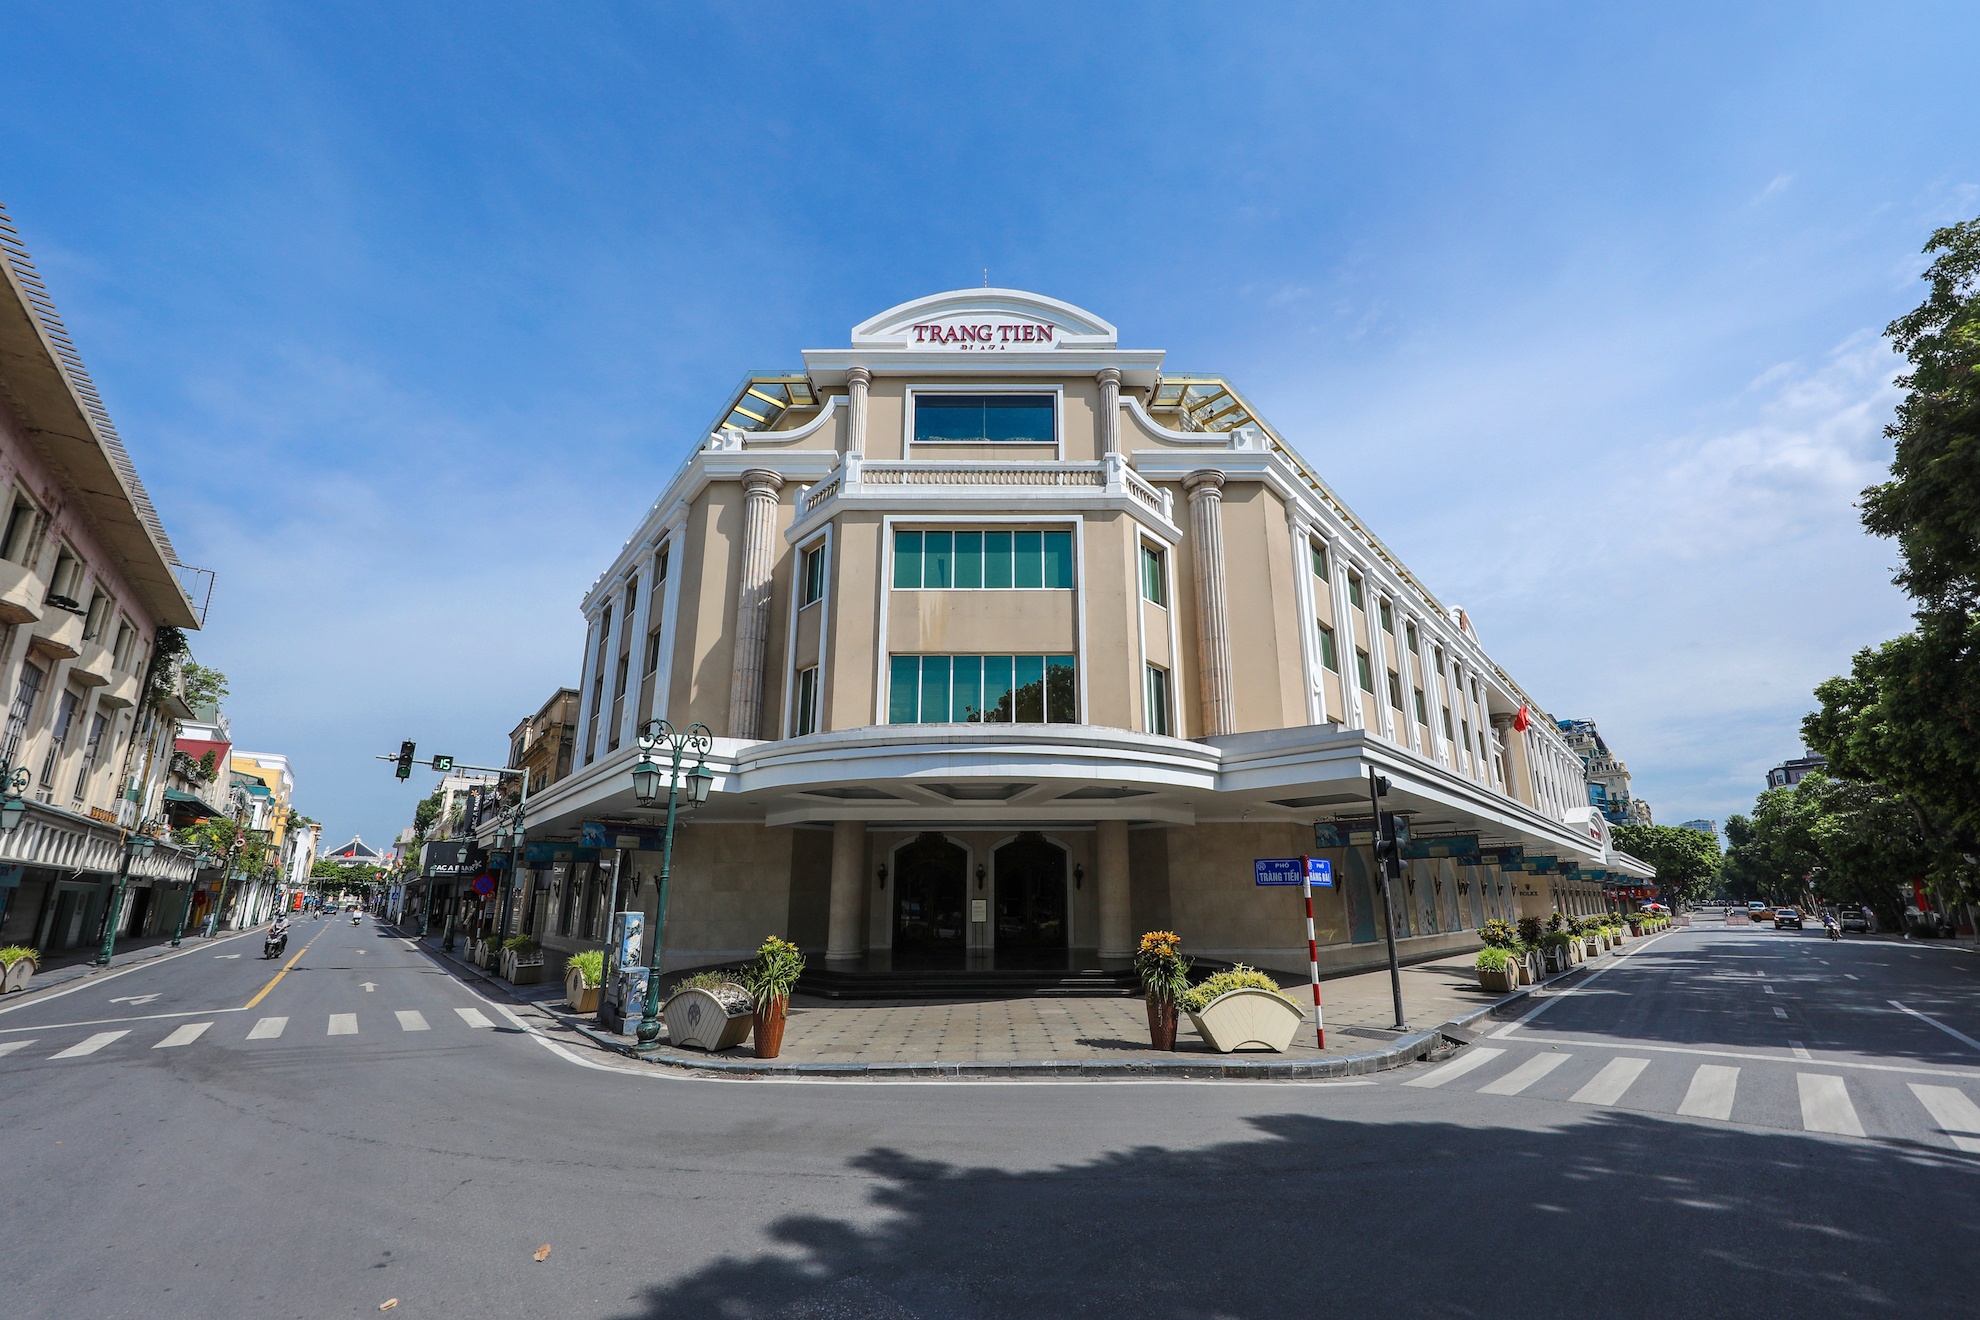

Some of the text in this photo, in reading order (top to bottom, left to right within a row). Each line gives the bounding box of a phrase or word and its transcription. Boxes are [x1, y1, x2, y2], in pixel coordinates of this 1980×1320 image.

[913, 325, 1055, 343] TRANG TIEN
[440, 759, 450, 770] 15
[1259, 870, 1283, 881] TRÀNG
